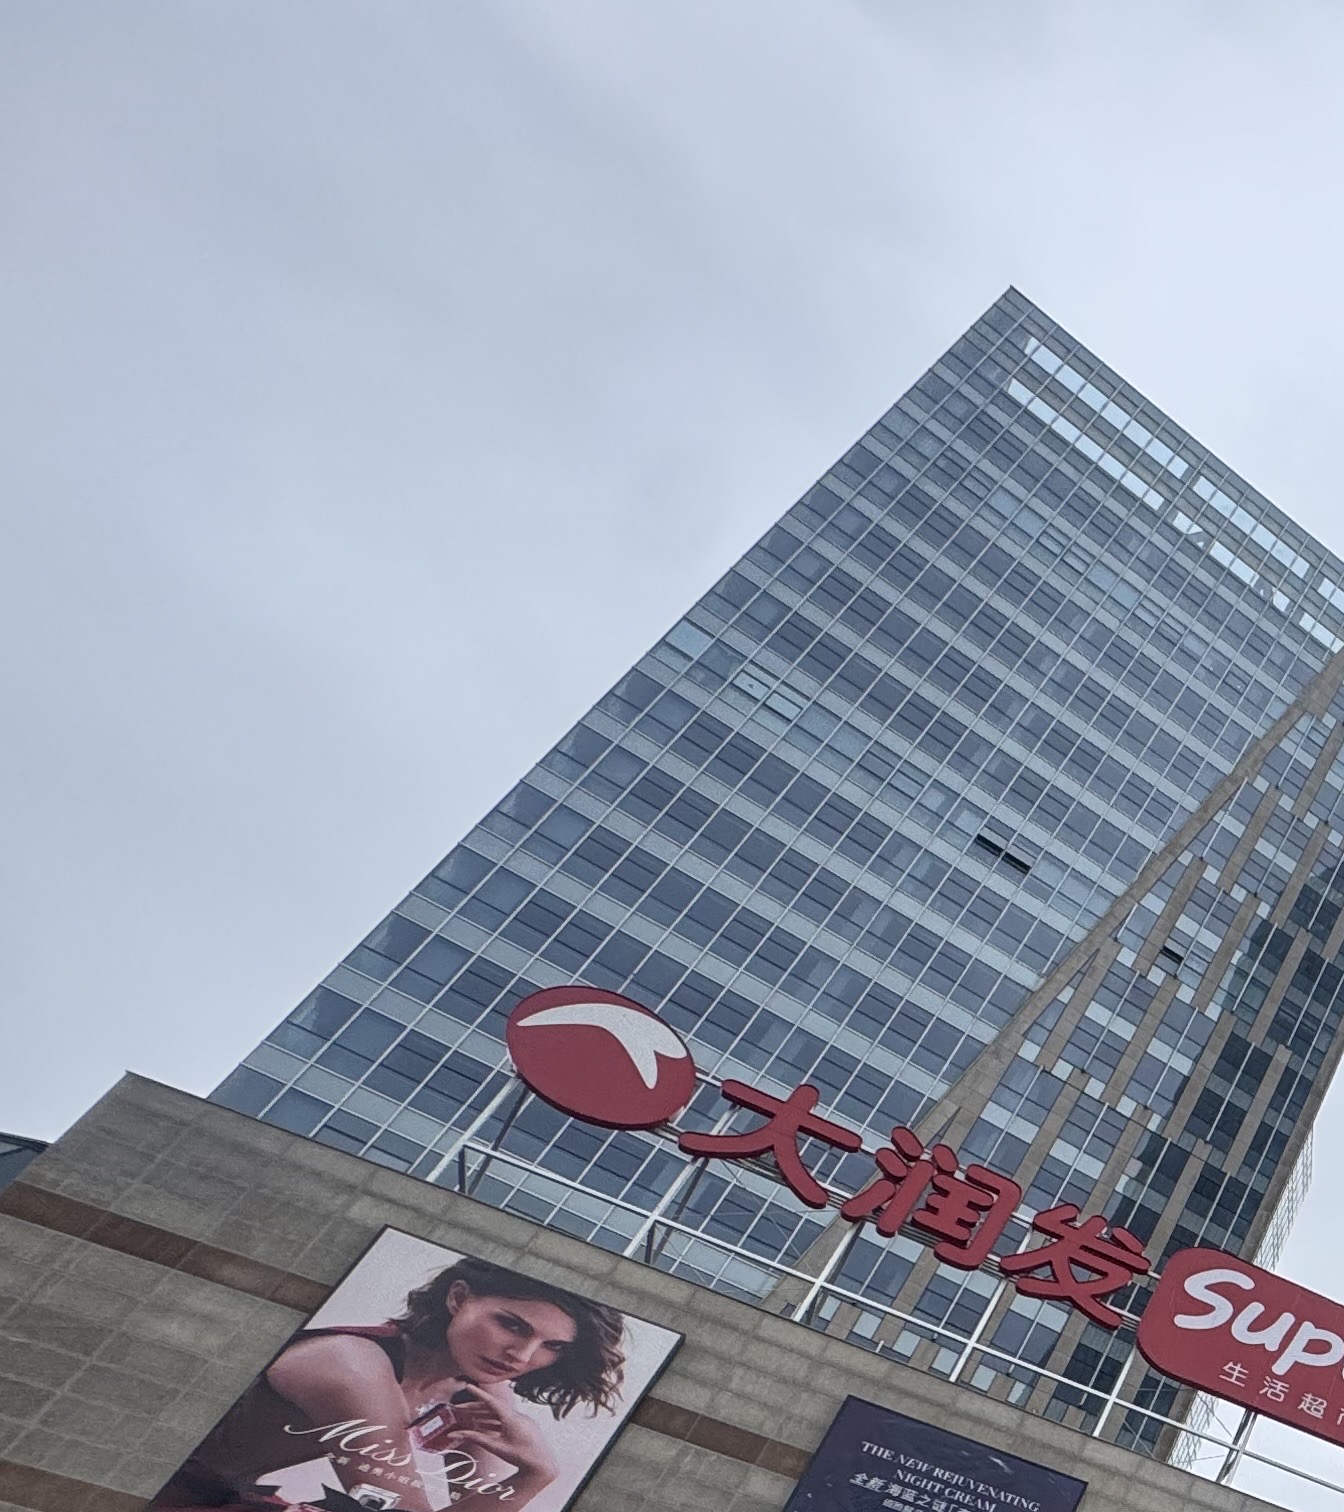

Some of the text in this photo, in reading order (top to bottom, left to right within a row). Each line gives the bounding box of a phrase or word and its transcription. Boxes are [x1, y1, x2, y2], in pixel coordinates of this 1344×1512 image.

[678, 1079, 1151, 1330] 大润发
[284, 1419, 516, 1501] Miss Dior
[861, 1441, 1041, 1512] THE NEW REJUVENATING
[893, 1469, 998, 1512] NIGHT CREAM
